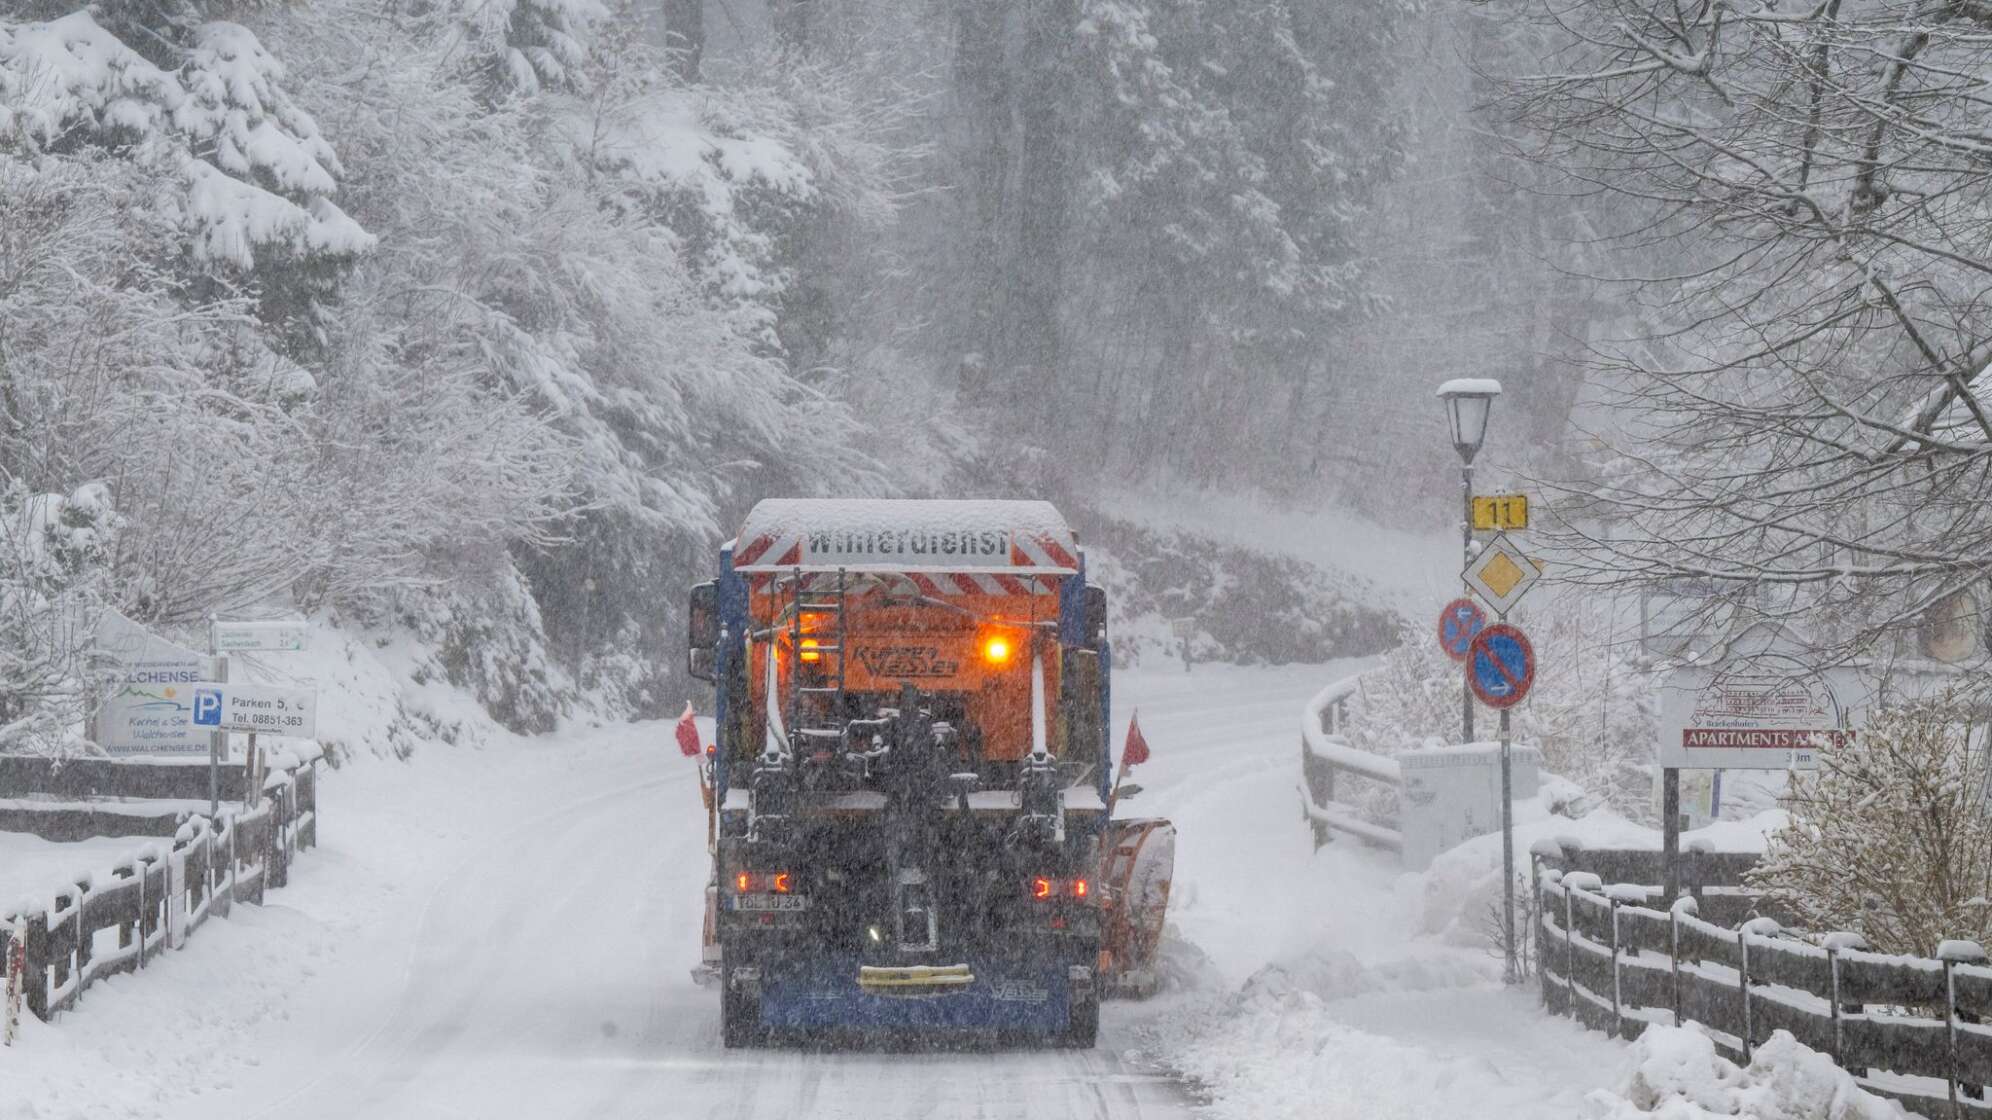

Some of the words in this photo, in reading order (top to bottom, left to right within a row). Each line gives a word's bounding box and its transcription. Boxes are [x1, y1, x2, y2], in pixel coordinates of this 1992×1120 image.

[1487, 502, 1513, 525] 11
[808, 530, 1009, 555] Winterdienst
[231, 697, 272, 709] Parken
[231, 713, 249, 724] Tel.
[1687, 732, 1789, 746] APARTMENTS
